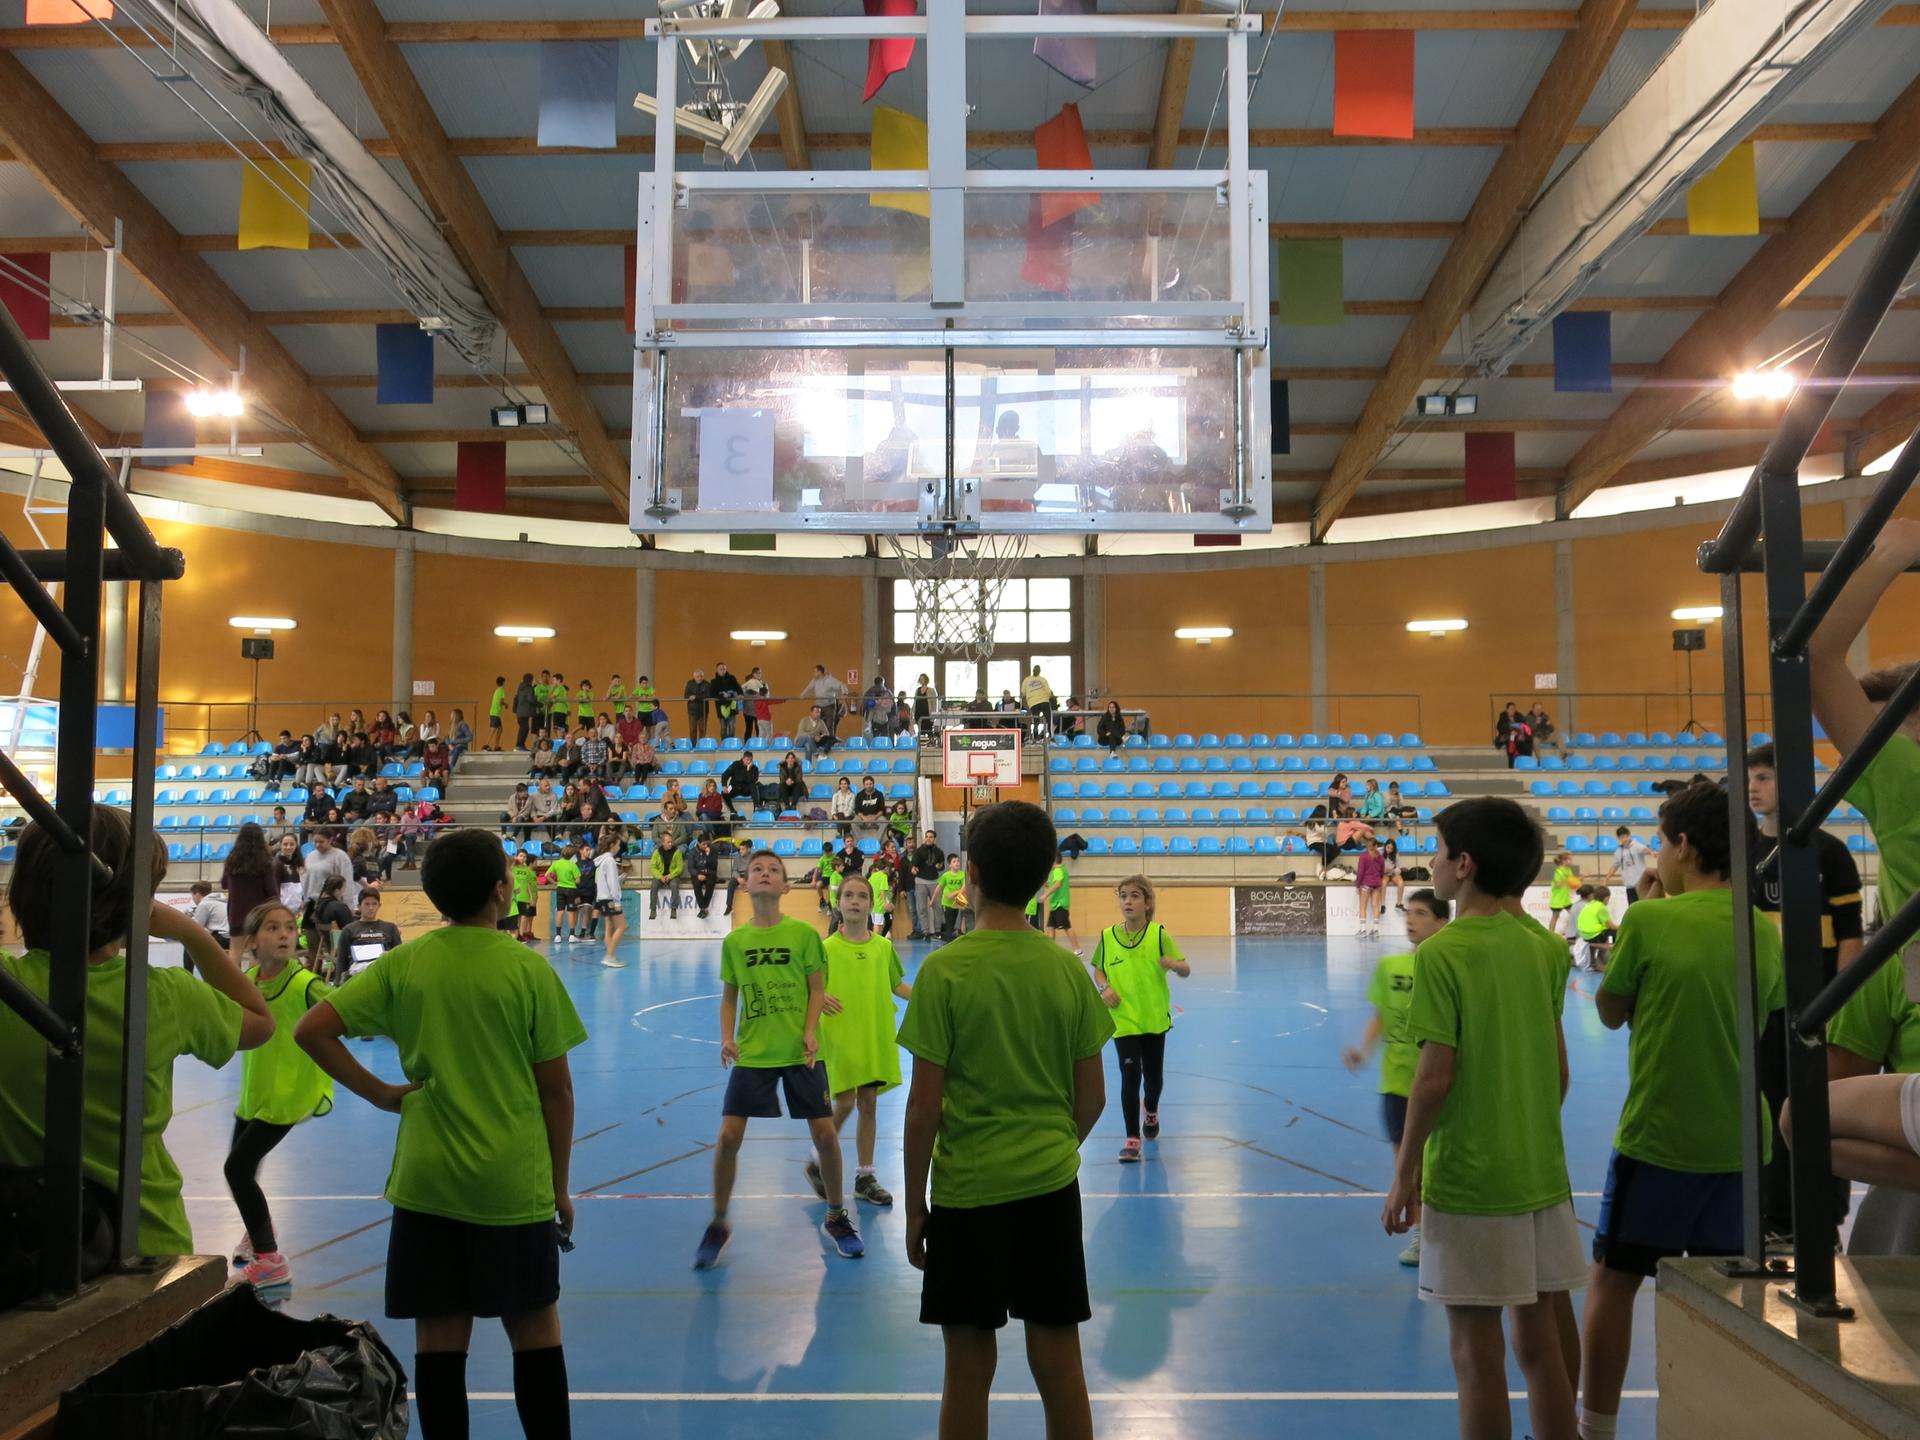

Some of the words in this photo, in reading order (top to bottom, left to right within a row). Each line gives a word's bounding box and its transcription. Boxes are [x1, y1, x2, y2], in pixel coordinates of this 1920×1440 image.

[971, 740, 997, 750] negua
[1250, 891, 1280, 901] BOGA
[1283, 891, 1314, 901] BOGA
[744, 947, 791, 968] 3X3
